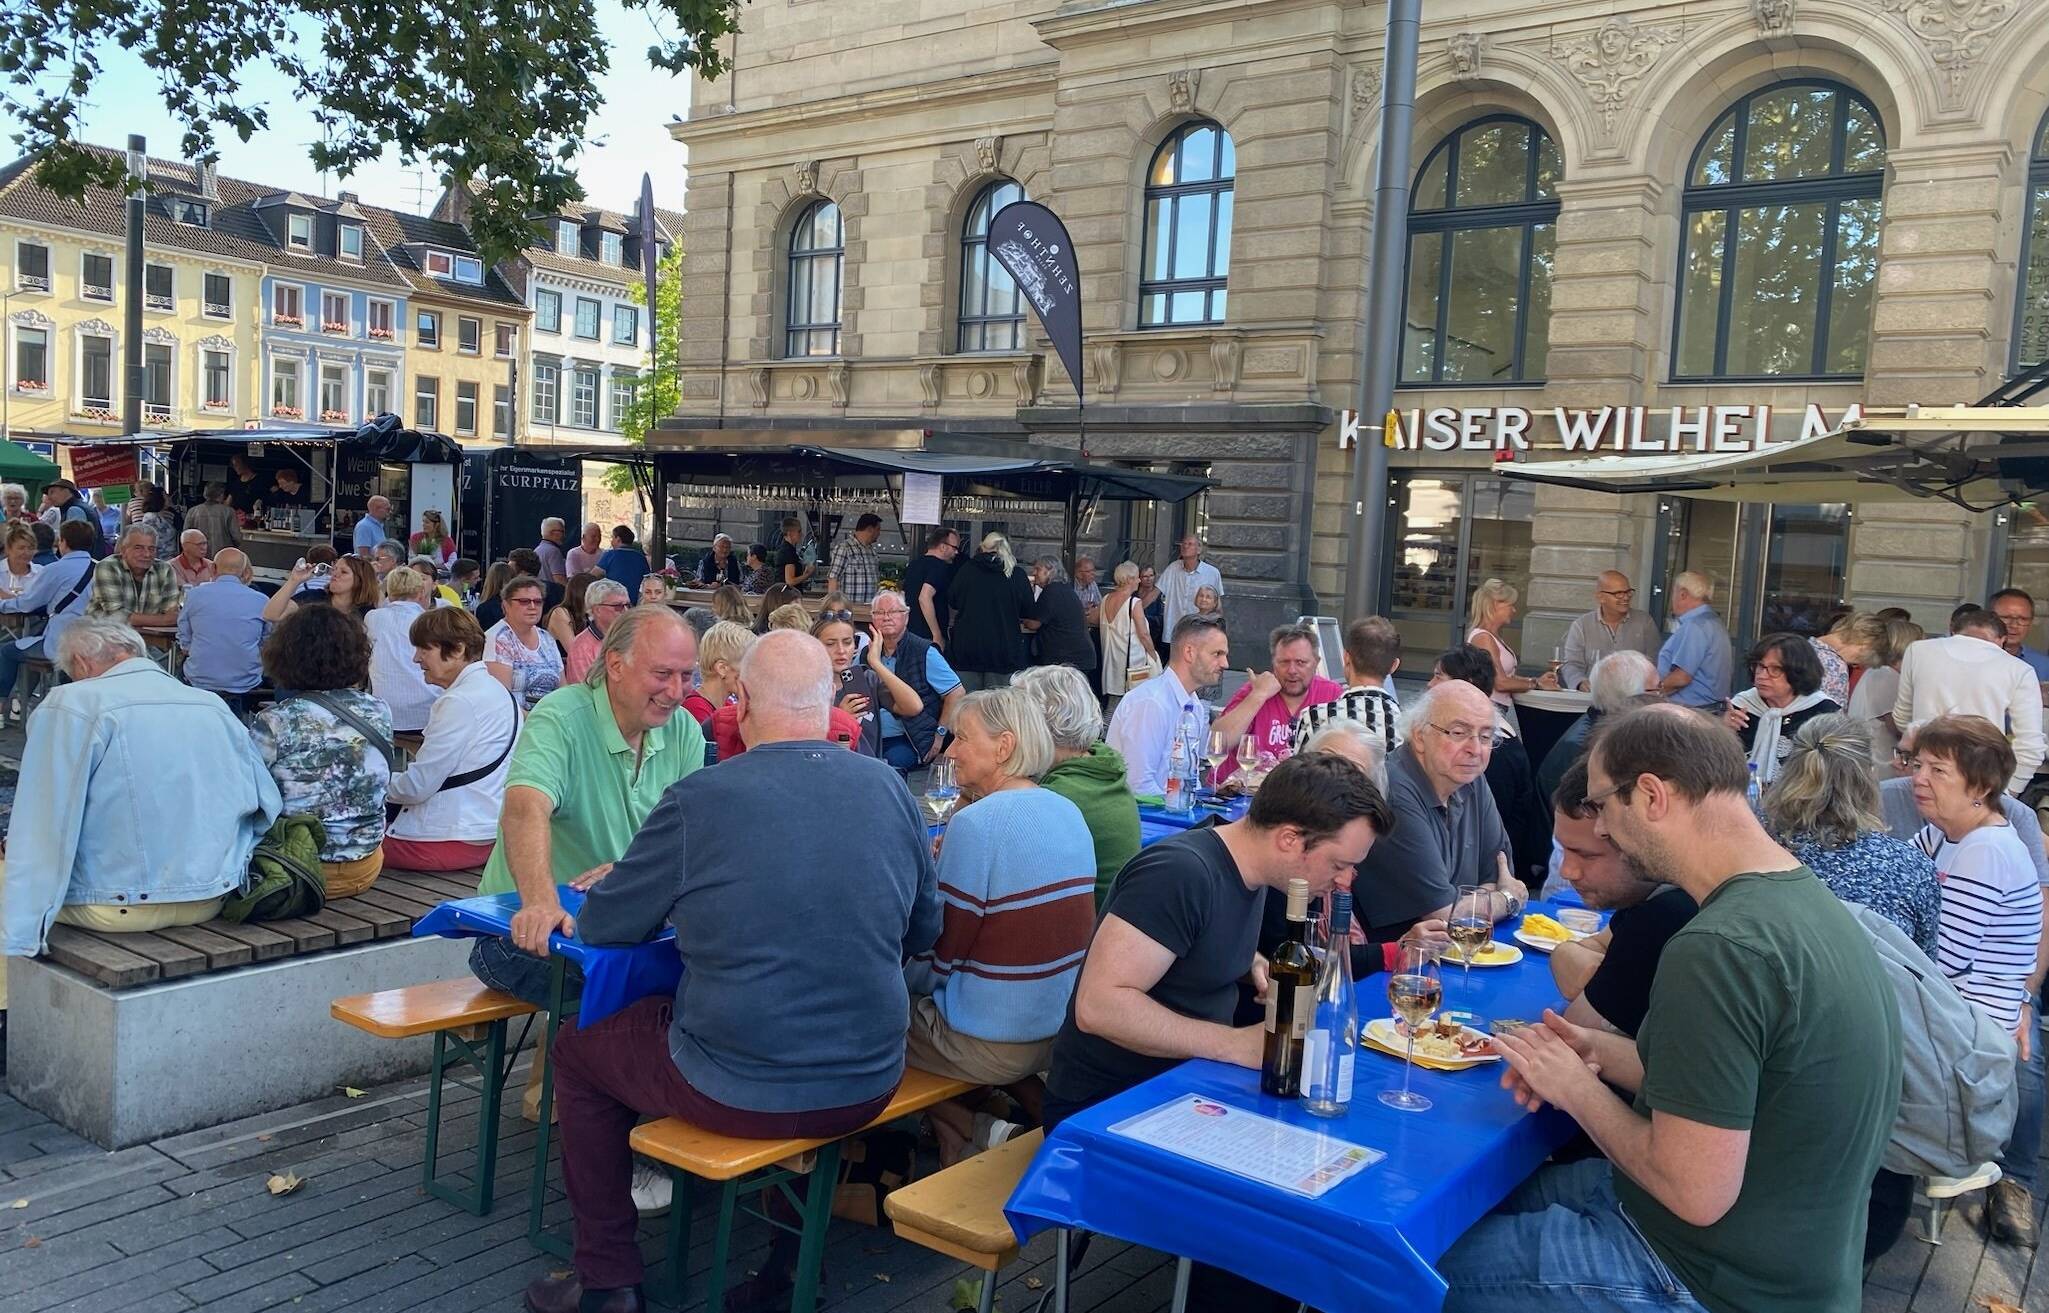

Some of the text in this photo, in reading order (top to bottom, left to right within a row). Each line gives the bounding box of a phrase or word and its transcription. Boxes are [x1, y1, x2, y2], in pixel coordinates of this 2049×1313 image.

[1554, 403, 1864, 451] WILHELM
[347, 456, 381, 472] Weinh
[336, 480, 360, 497] Uwe
[500, 475, 578, 491] KURPFALZ
